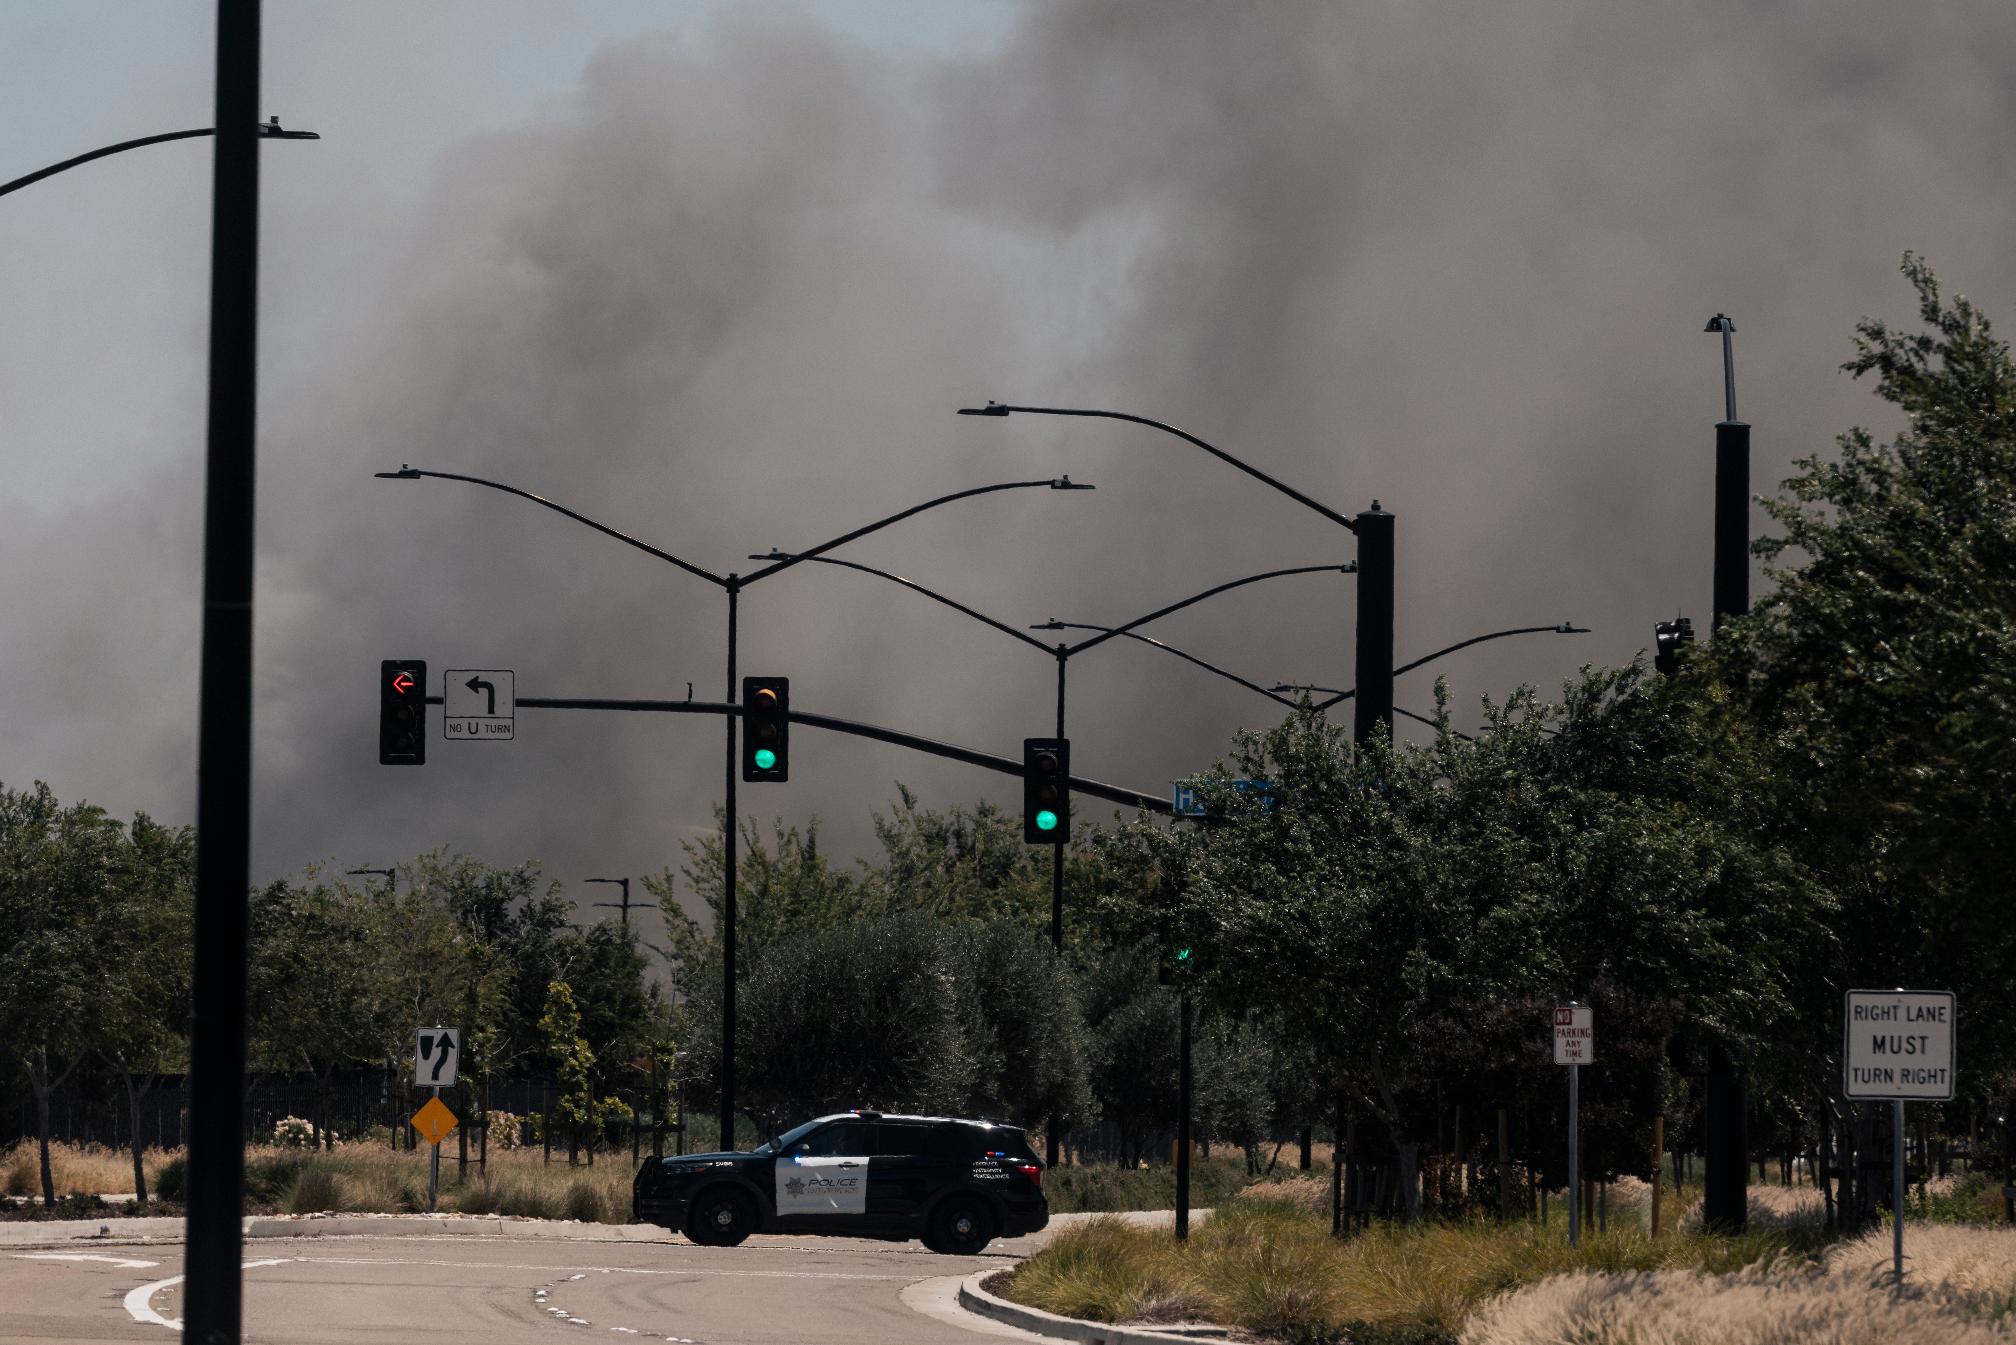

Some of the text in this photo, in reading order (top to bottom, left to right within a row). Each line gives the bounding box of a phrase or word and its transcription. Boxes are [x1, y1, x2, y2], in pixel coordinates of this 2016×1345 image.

[449, 721, 511, 735] NO U TURN
[1556, 1010, 1570, 1024] NO
[1854, 1004, 1947, 1023] RIGHT LANE
[1556, 1027, 1591, 1039] PARKING
[1565, 1039, 1581, 1049] ANY
[1872, 1034, 1928, 1055] MUST
[1565, 1049, 1583, 1058] TIME
[1852, 1067, 1948, 1085] TURN RIGHT
[808, 1177, 858, 1188] POLICE
